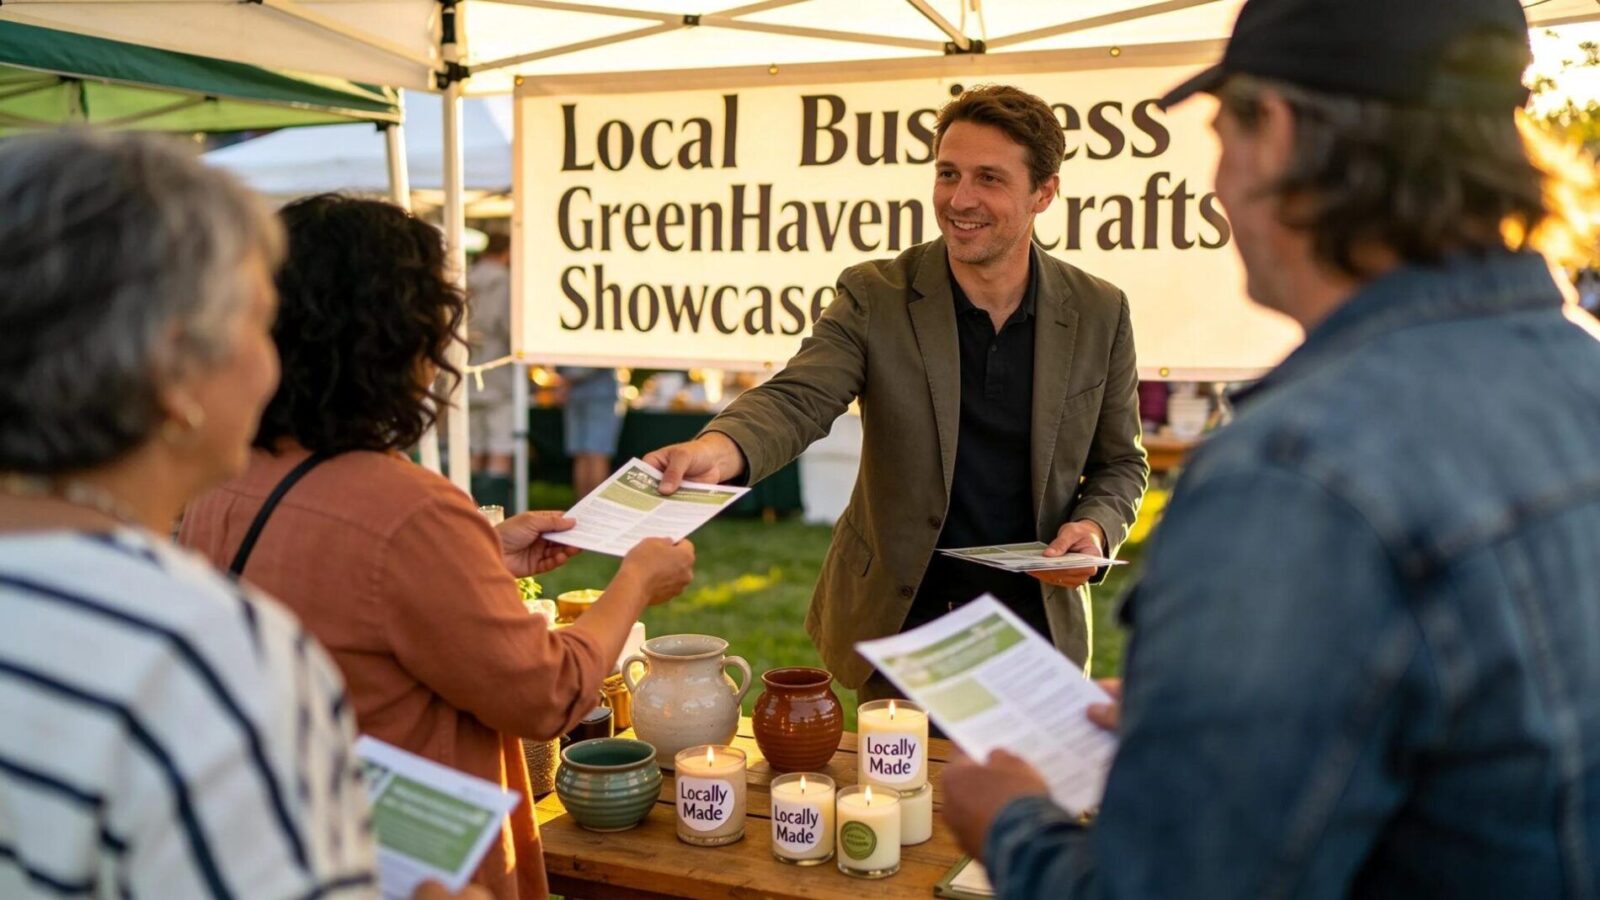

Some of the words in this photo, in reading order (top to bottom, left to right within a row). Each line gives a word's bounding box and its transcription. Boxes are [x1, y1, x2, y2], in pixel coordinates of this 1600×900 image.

[560, 93, 739, 171] Local
[799, 84, 1171, 167] Busess
[557, 184, 924, 252] GreenHaven
[1033, 171, 1231, 251] rafts
[560, 264, 838, 336] Showcase
[867, 736, 916, 759] Locally
[869, 757, 912, 775] Made
[680, 781, 728, 806] Locally
[683, 803, 723, 821] Made
[774, 804, 819, 828] Locally
[776, 824, 815, 844] Made
